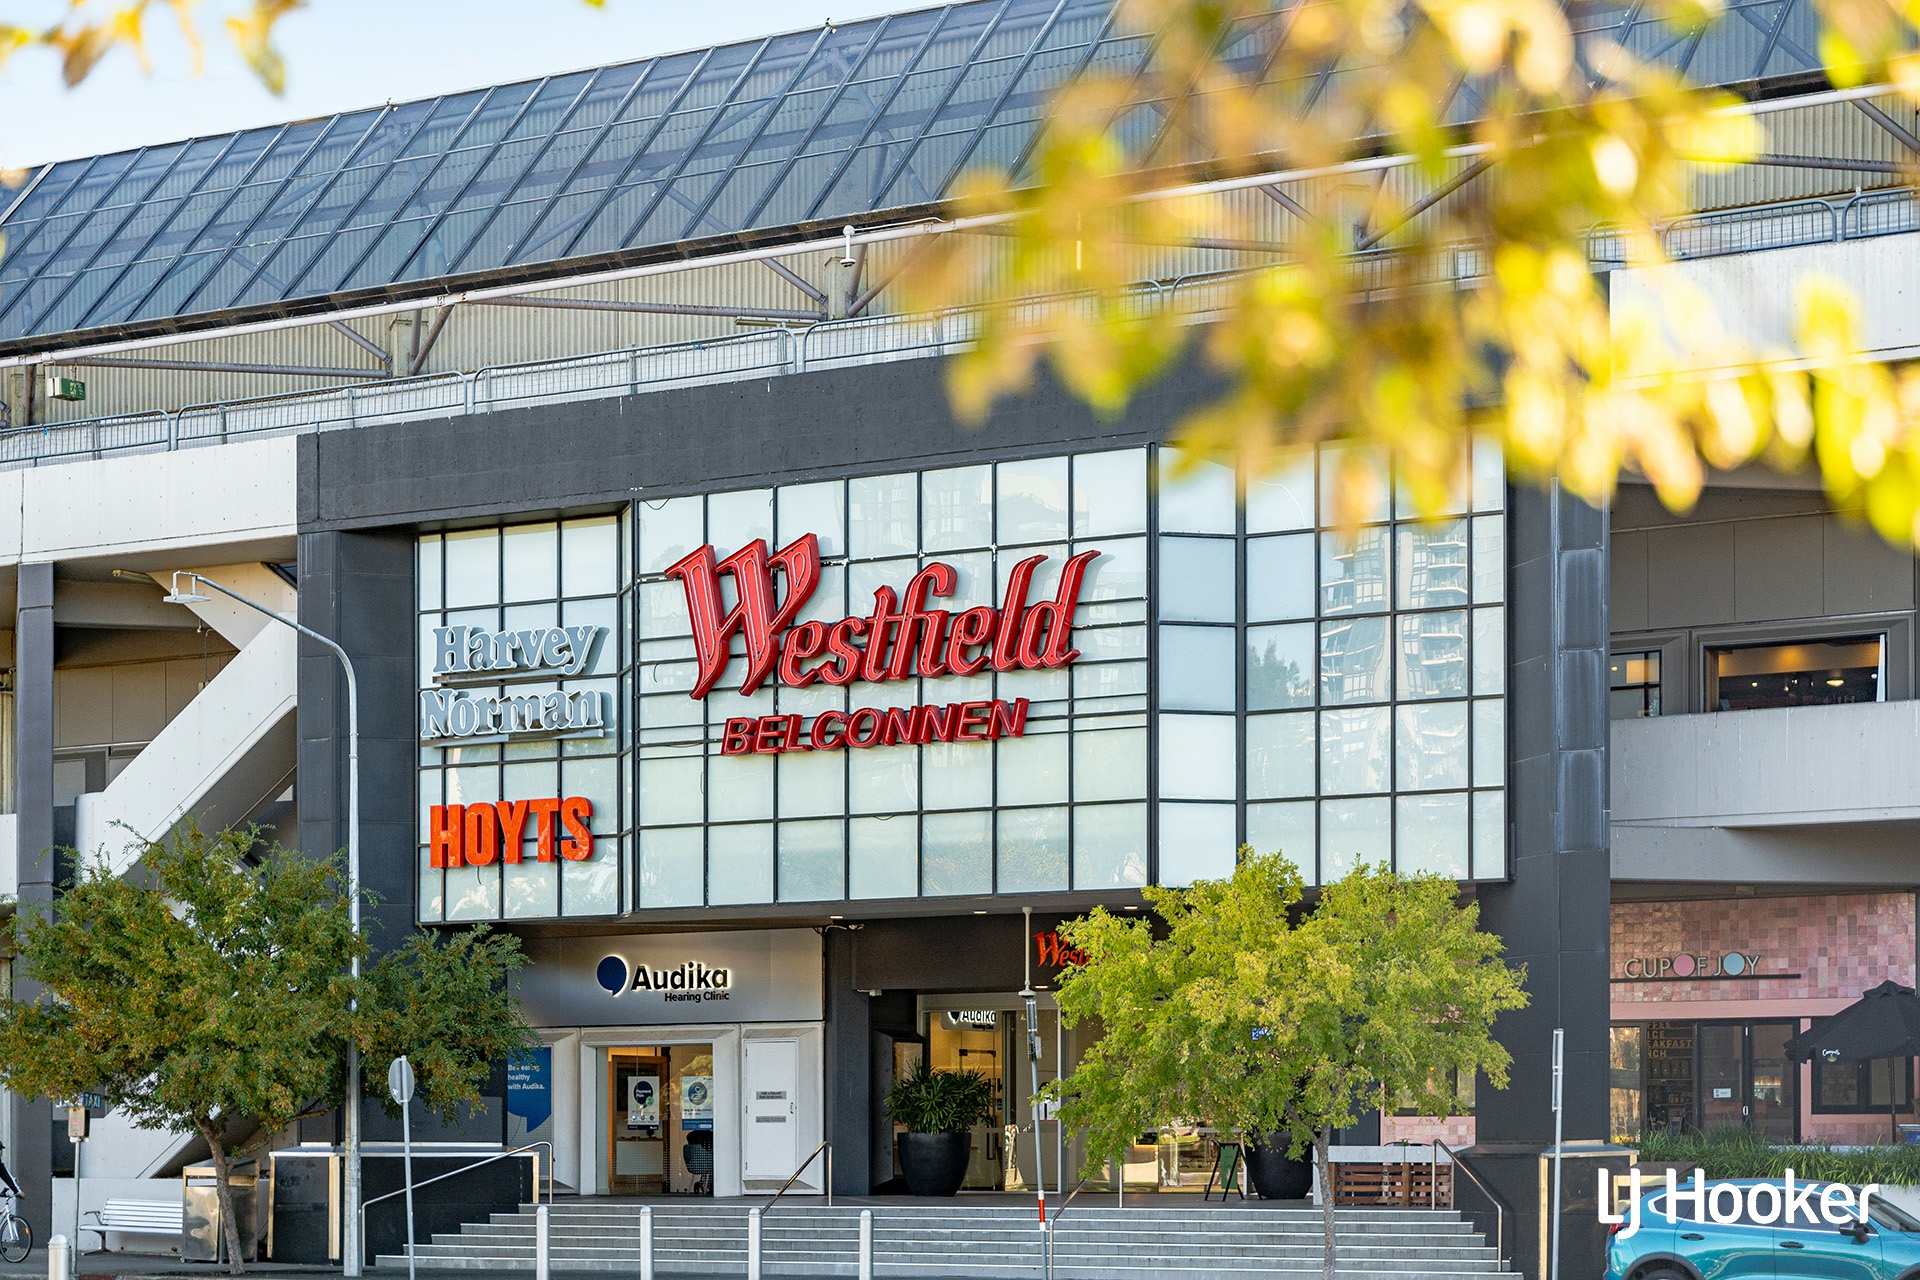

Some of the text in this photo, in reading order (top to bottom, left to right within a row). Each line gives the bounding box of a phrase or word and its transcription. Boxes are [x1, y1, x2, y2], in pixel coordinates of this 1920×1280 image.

[664, 532, 1101, 700] Westfield
[432, 624, 598, 676] Harvey
[420, 689, 603, 738] Norman
[720, 697, 1030, 757] BELCONNEN
[429, 796, 594, 869] HOYTS
[631, 961, 730, 991] Audika
[1713, 952, 1760, 977] JOY
[664, 990, 730, 1003] Hearing Clinic
[1647, 1030, 1665, 1039] ICE
[1647, 1039, 1692, 1048] EAKFAST
[1647, 1049, 1667, 1058] NCH
[507, 1082, 521, 1090] with
[508, 1073, 530, 1081] healthy
